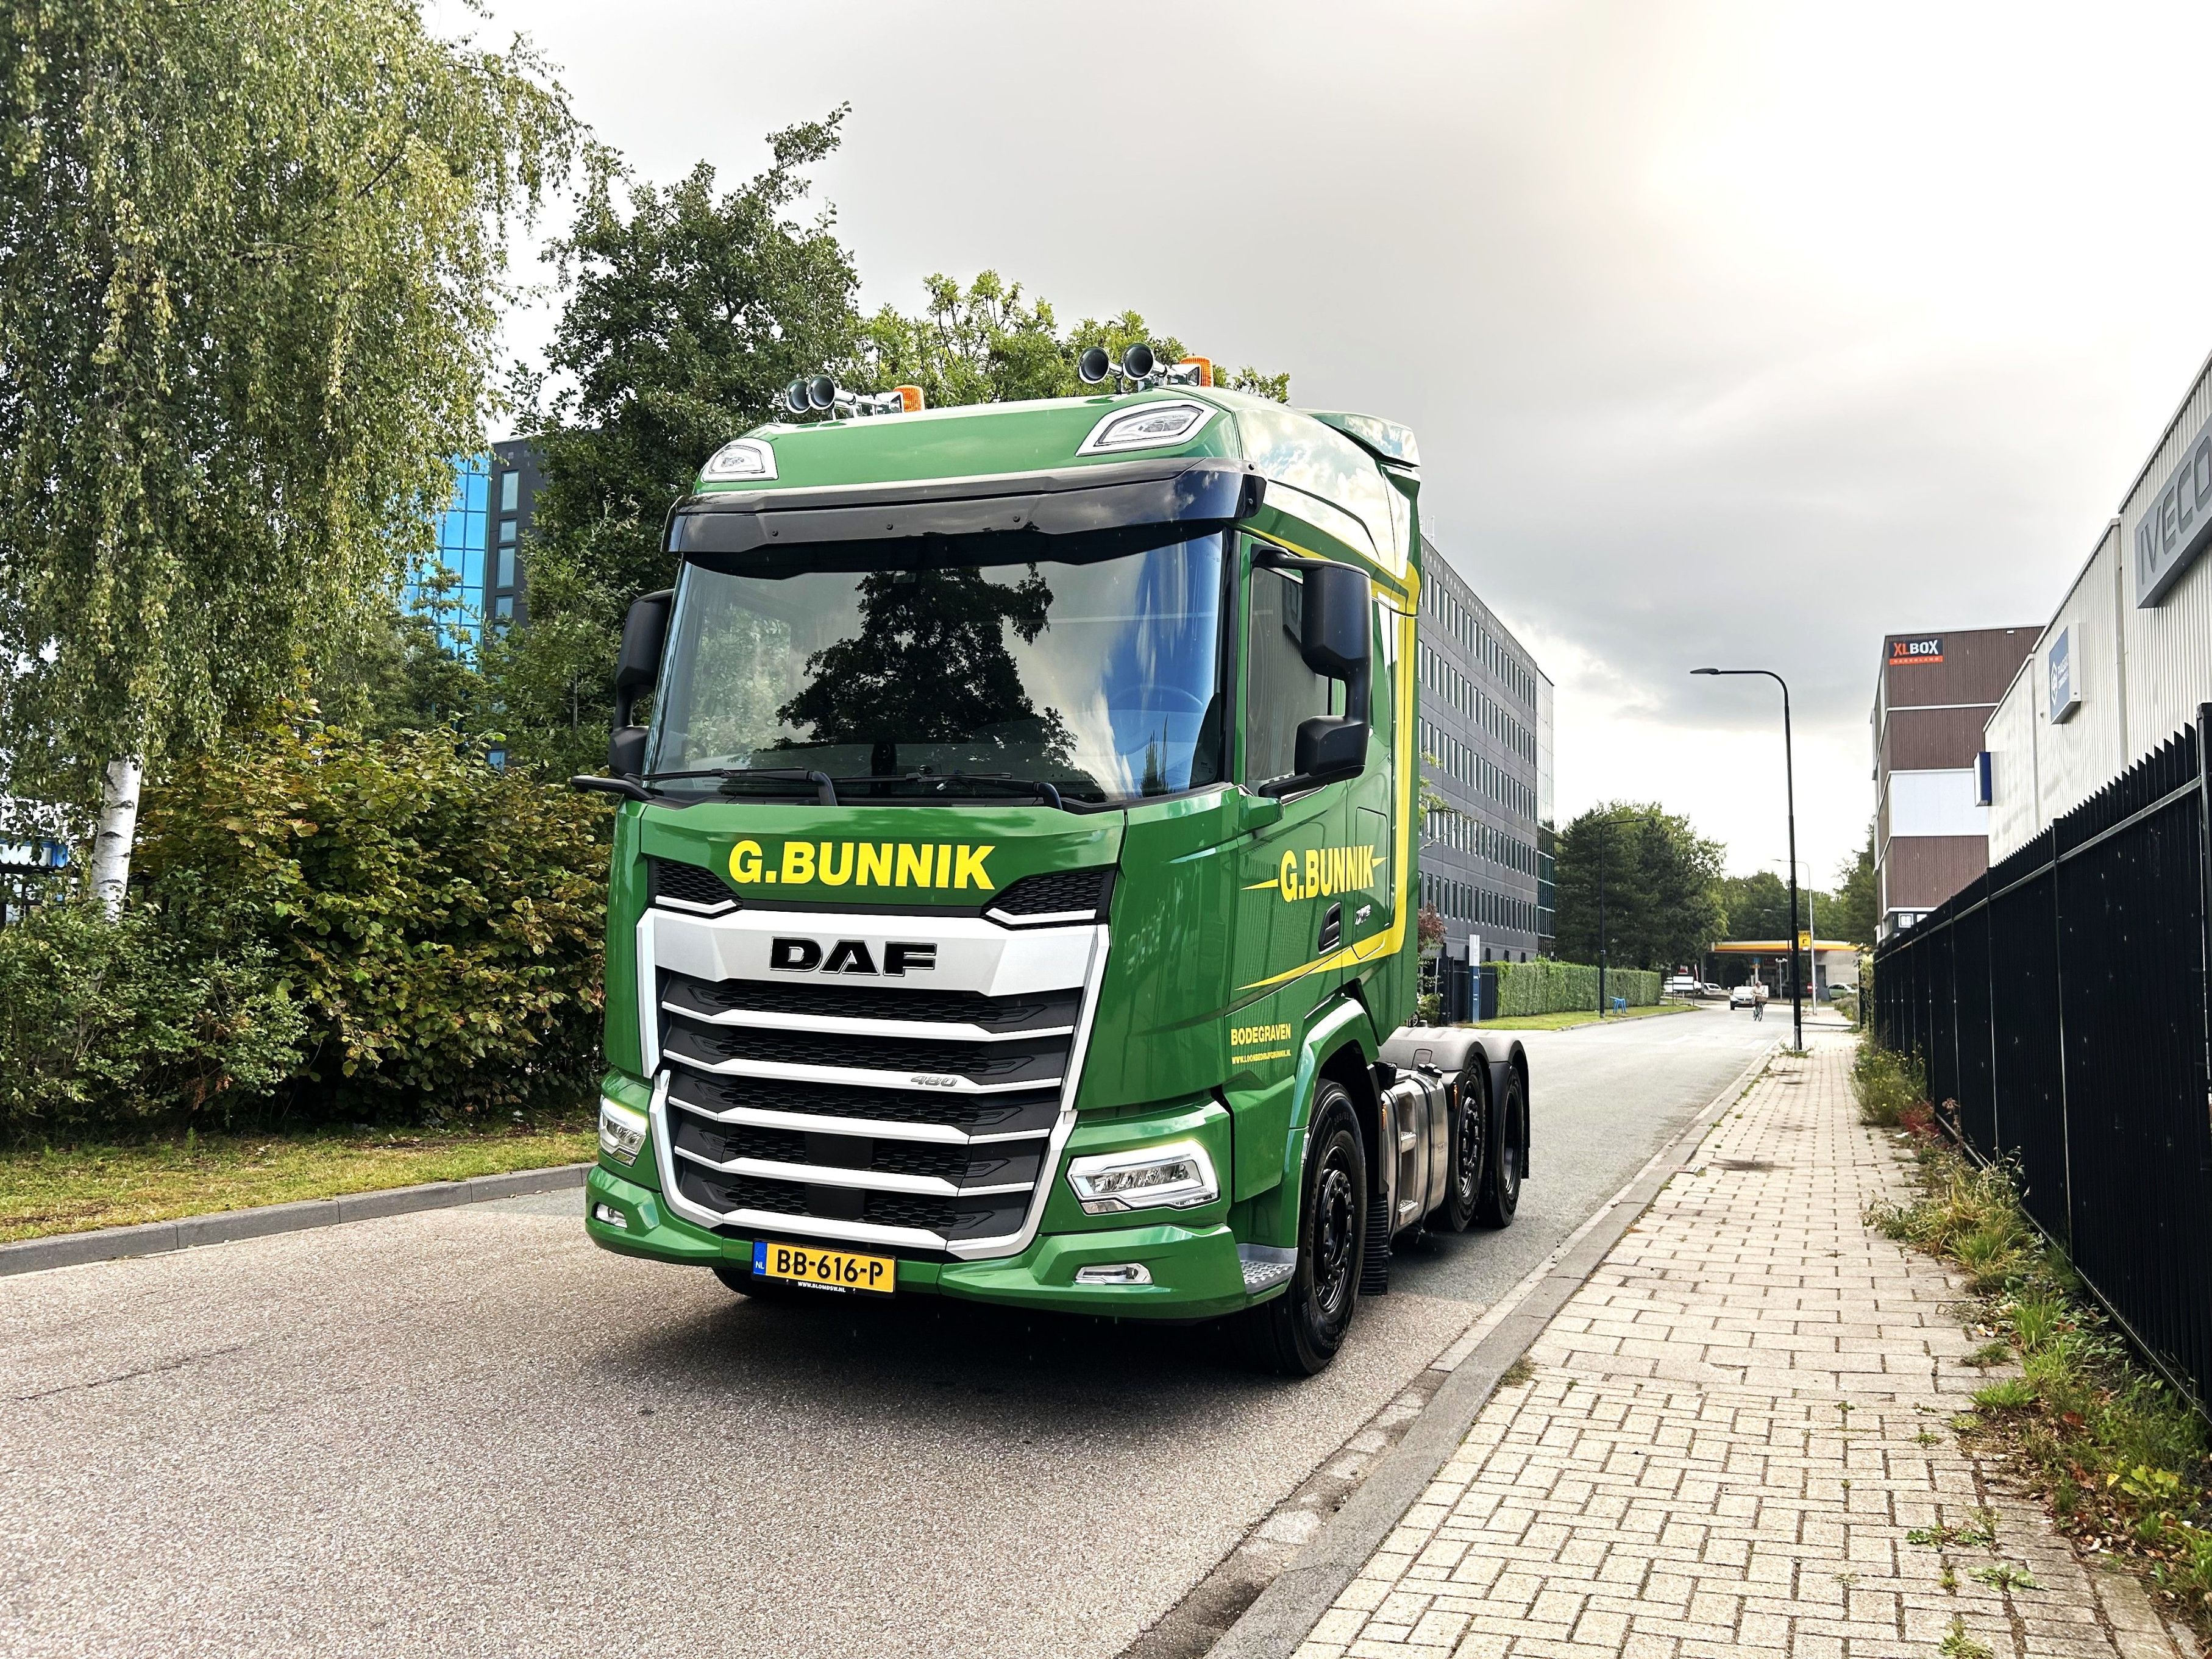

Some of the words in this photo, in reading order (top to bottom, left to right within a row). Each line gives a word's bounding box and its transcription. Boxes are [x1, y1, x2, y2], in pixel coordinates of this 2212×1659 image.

[2141, 436, 2212, 585] IVECO
[728, 840, 996, 890] G.BUNNIK
[1281, 845, 1374, 902] G.BUNNIK
[769, 936, 937, 977] DAF
[1231, 1023, 1291, 1046] BODEGRAVEN
[911, 1076, 957, 1087] 480
[755, 1261, 764, 1270] NL
[777, 1249, 883, 1285] BB-616-P
